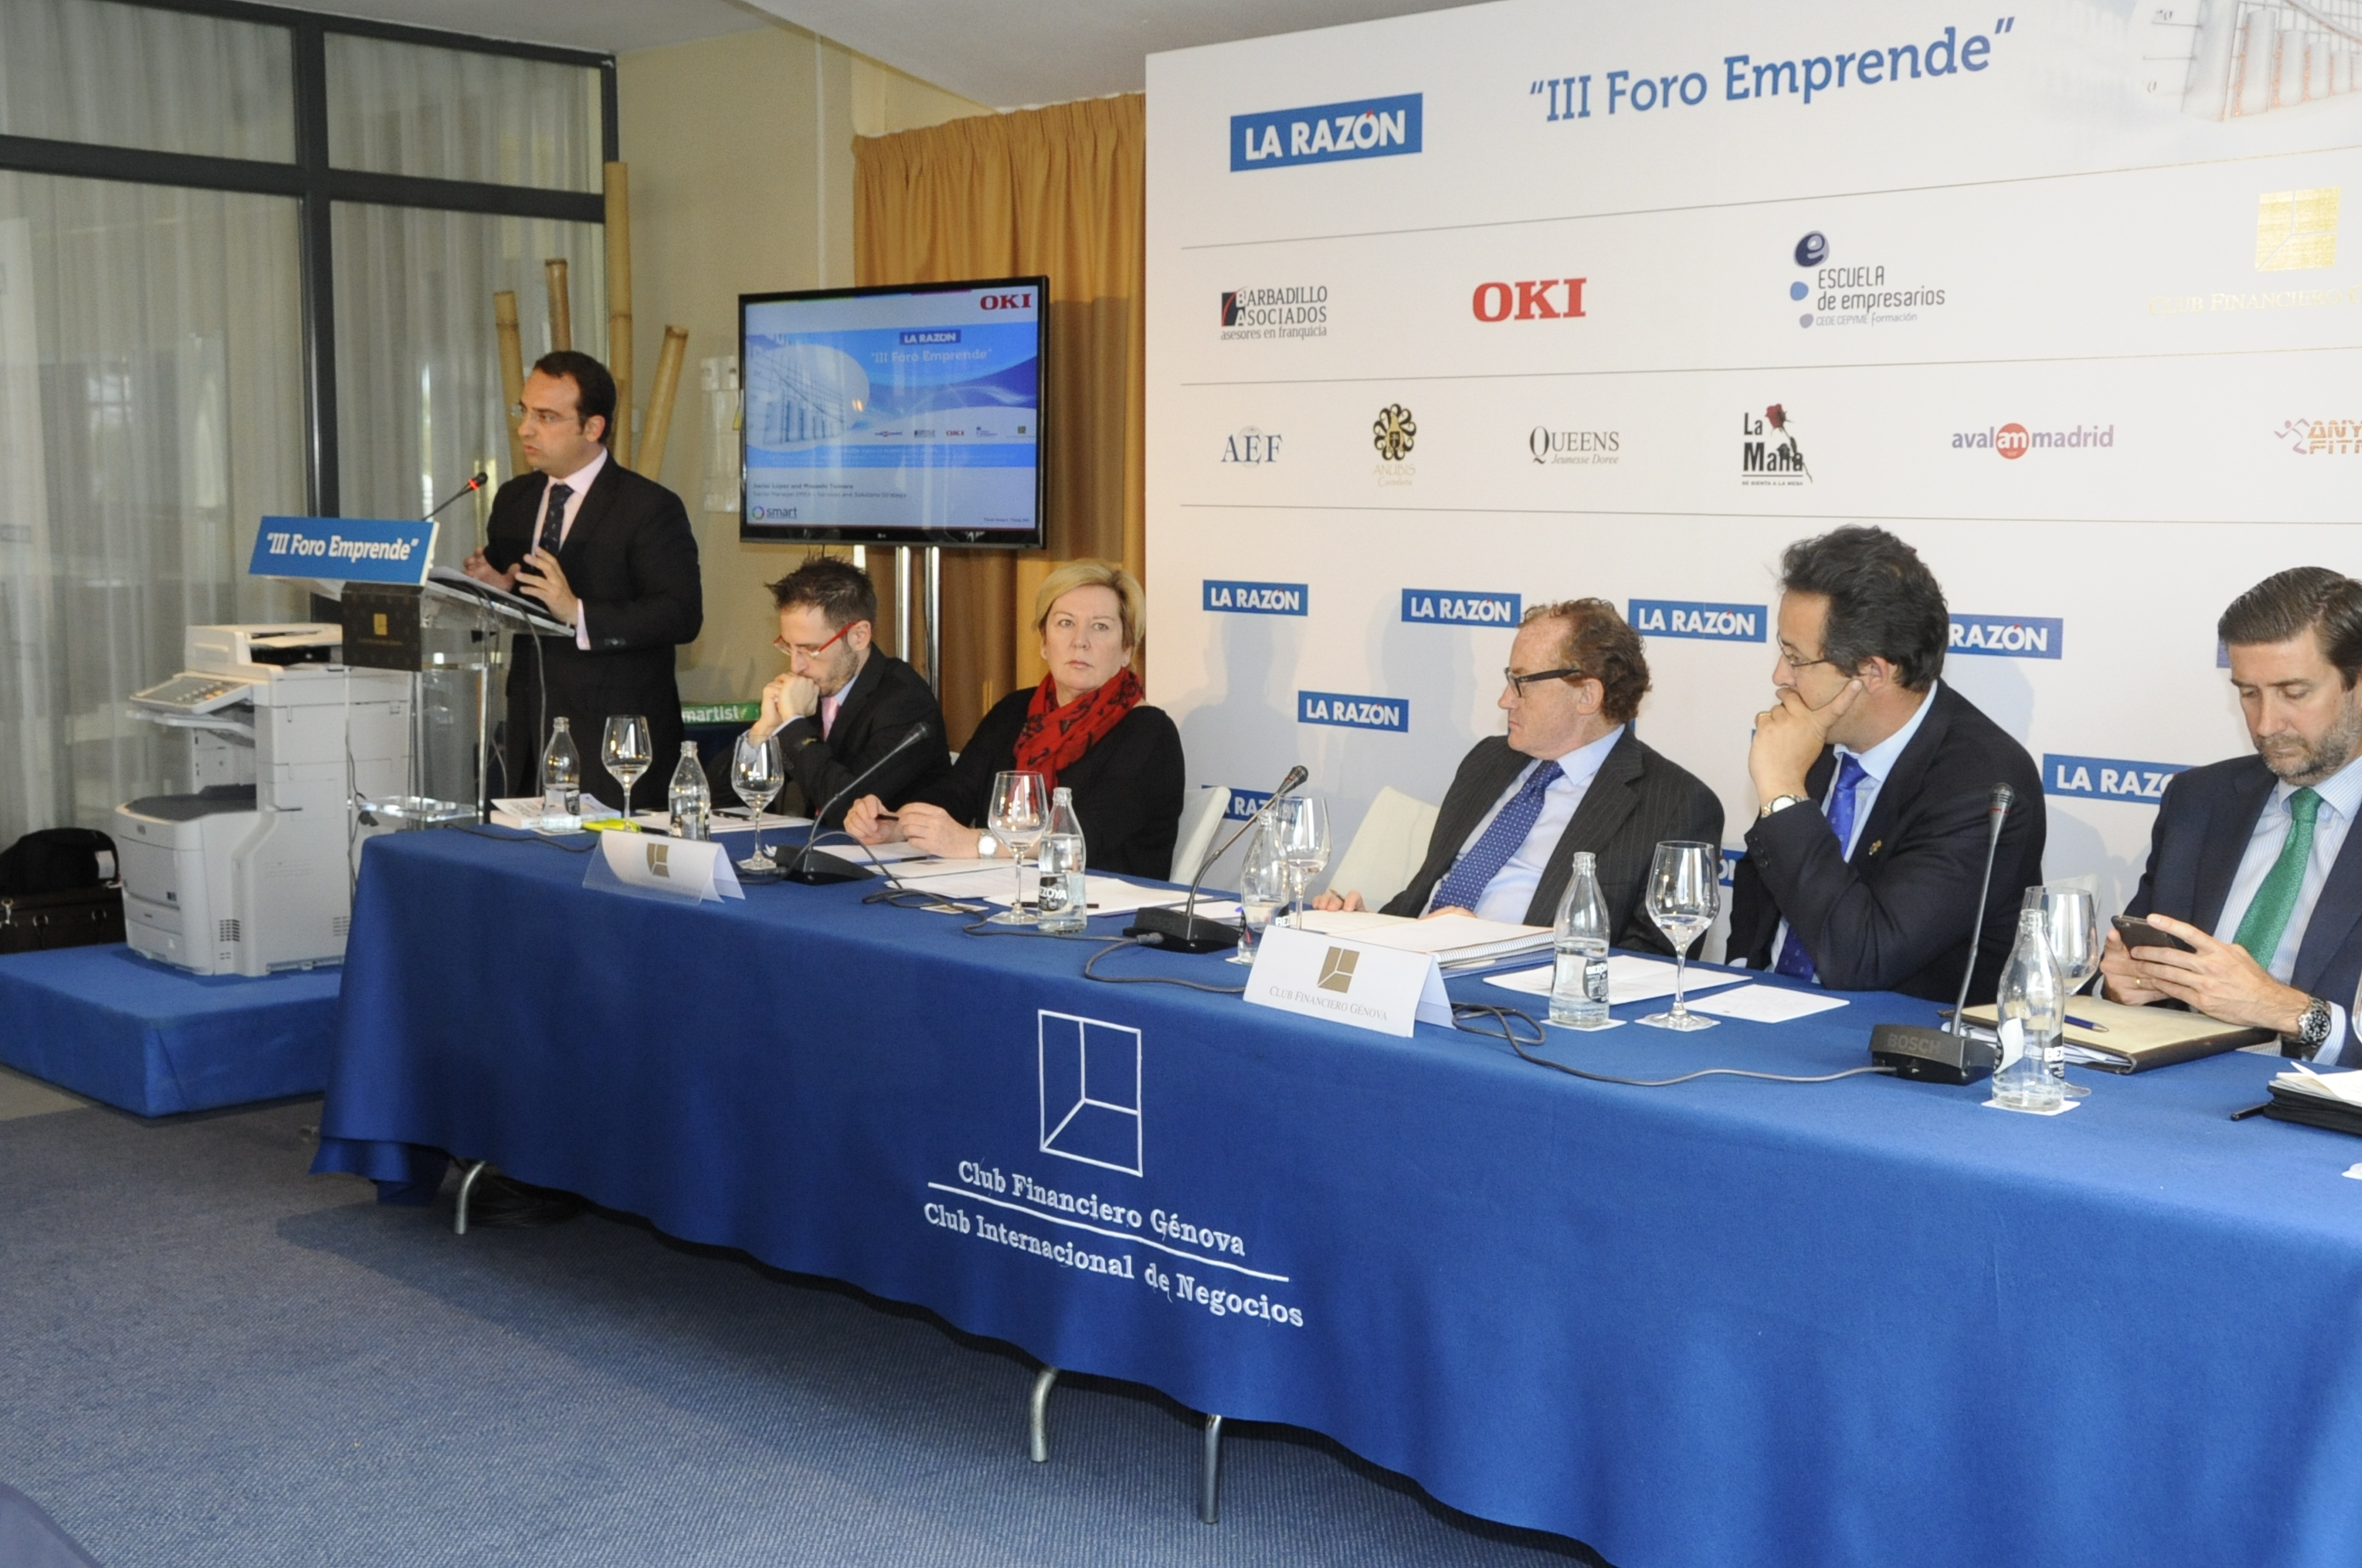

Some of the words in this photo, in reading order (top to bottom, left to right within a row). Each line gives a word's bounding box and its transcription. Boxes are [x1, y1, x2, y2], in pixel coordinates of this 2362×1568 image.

[1607, 70, 1708, 115] Foro
[1245, 125, 1282, 160] LA
[1291, 109, 1405, 156] RAZÓN
[1818, 266, 1885, 289] ESCUELA
[980, 294, 1032, 311] OKI
[1236, 285, 1328, 307] BARBADILLO
[1472, 277, 1587, 322] OKI
[1817, 291, 1836, 311] de
[1841, 285, 1945, 314] empresarios
[2149, 297, 2203, 315] CLUB
[2210, 288, 2342, 312] FINANCIERO
[1234, 305, 1327, 326] ASOCIADOS
[1871, 311, 1917, 327] formación
[904, 333, 917, 344] LA
[1221, 329, 1262, 340] asesores
[1263, 328, 1276, 339] en
[1279, 325, 1327, 340] franquicia
[892, 350, 920, 362] Foro
[1744, 412, 1763, 435] La
[1220, 434, 1283, 465] AEF
[1530, 426, 1620, 464] QUEENS
[1372, 463, 1416, 476] ANUBIS
[1551, 454, 1591, 464] Jeunesse
[766, 507, 798, 518] smart
[290, 534, 326, 557] Foro
[1211, 587, 1233, 607] LA
[1236, 588, 1299, 611] RAZÓN
[1411, 596, 1435, 619] LA
[1440, 597, 1511, 622] RAZÓN
[1638, 608, 1666, 630] LA
[1671, 610, 1755, 636] RAZÓN
[1949, 623, 2047, 652] RAZÓN
[681, 706, 740, 722] martist
[1307, 698, 1329, 720] LA
[1333, 701, 1399, 726] RAZÓN
[2057, 764, 2093, 792] LA
[2100, 769, 2174, 798] RAZ
[1269, 986, 1292, 1000] CLUB
[1295, 991, 1348, 1012] FINANCIERO
[1350, 1003, 1387, 1021] GÉNOVA
[1887, 1033, 1941, 1054] BOSCH
[958, 1161, 1005, 1193] Club
[1012, 1173, 1142, 1228] Financiero
[1150, 1209, 1245, 1256] Génova
[924, 1203, 971, 1235] Club
[976, 1215, 1134, 1280] Internacional
[1145, 1263, 1170, 1291] de
[1176, 1273, 1303, 1327] Negocios
